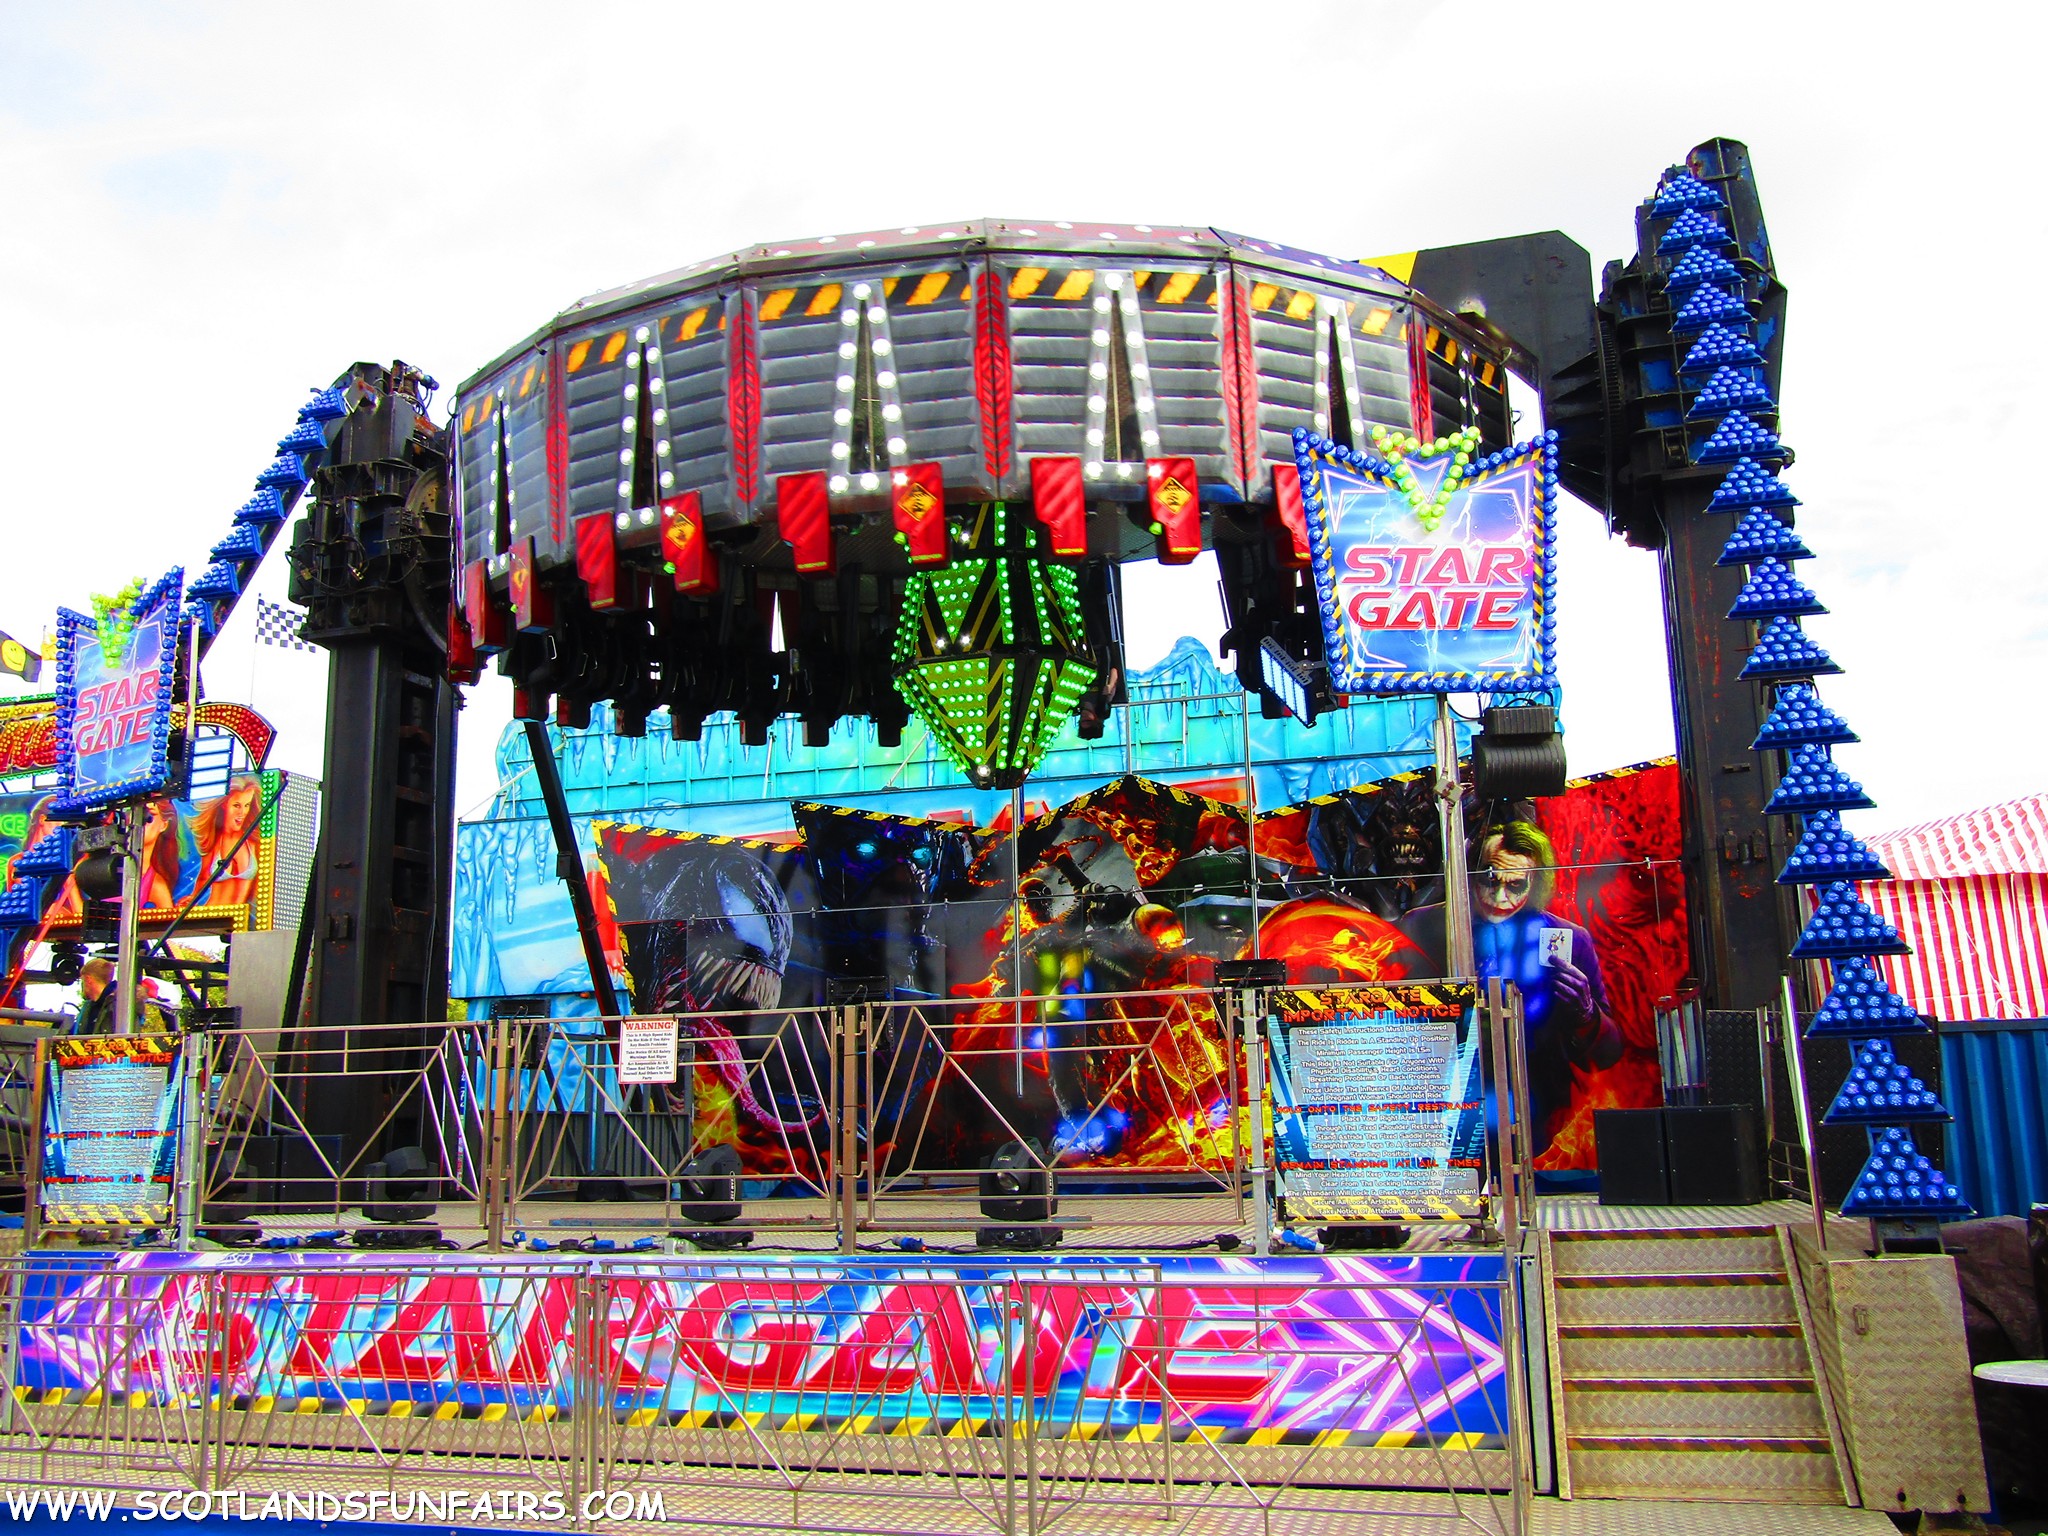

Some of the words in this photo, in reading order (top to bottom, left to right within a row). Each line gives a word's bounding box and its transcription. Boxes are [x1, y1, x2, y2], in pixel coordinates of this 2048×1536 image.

[1341, 546, 1528, 585] STAR
[1348, 590, 1526, 630] GATE
[75, 669, 161, 721] STAR
[76, 706, 157, 758] GATE
[1320, 989, 1420, 1005] STARGATE
[626, 1022, 673, 1030] WARNING!
[84, 1040, 149, 1053] STARGATE
[1342, 1104, 1362, 1112] THE
[1368, 1103, 1410, 1112] SAFETY
[1330, 1160, 1388, 1168] STANDING
[131, 1270, 1323, 1402] STARGATE
